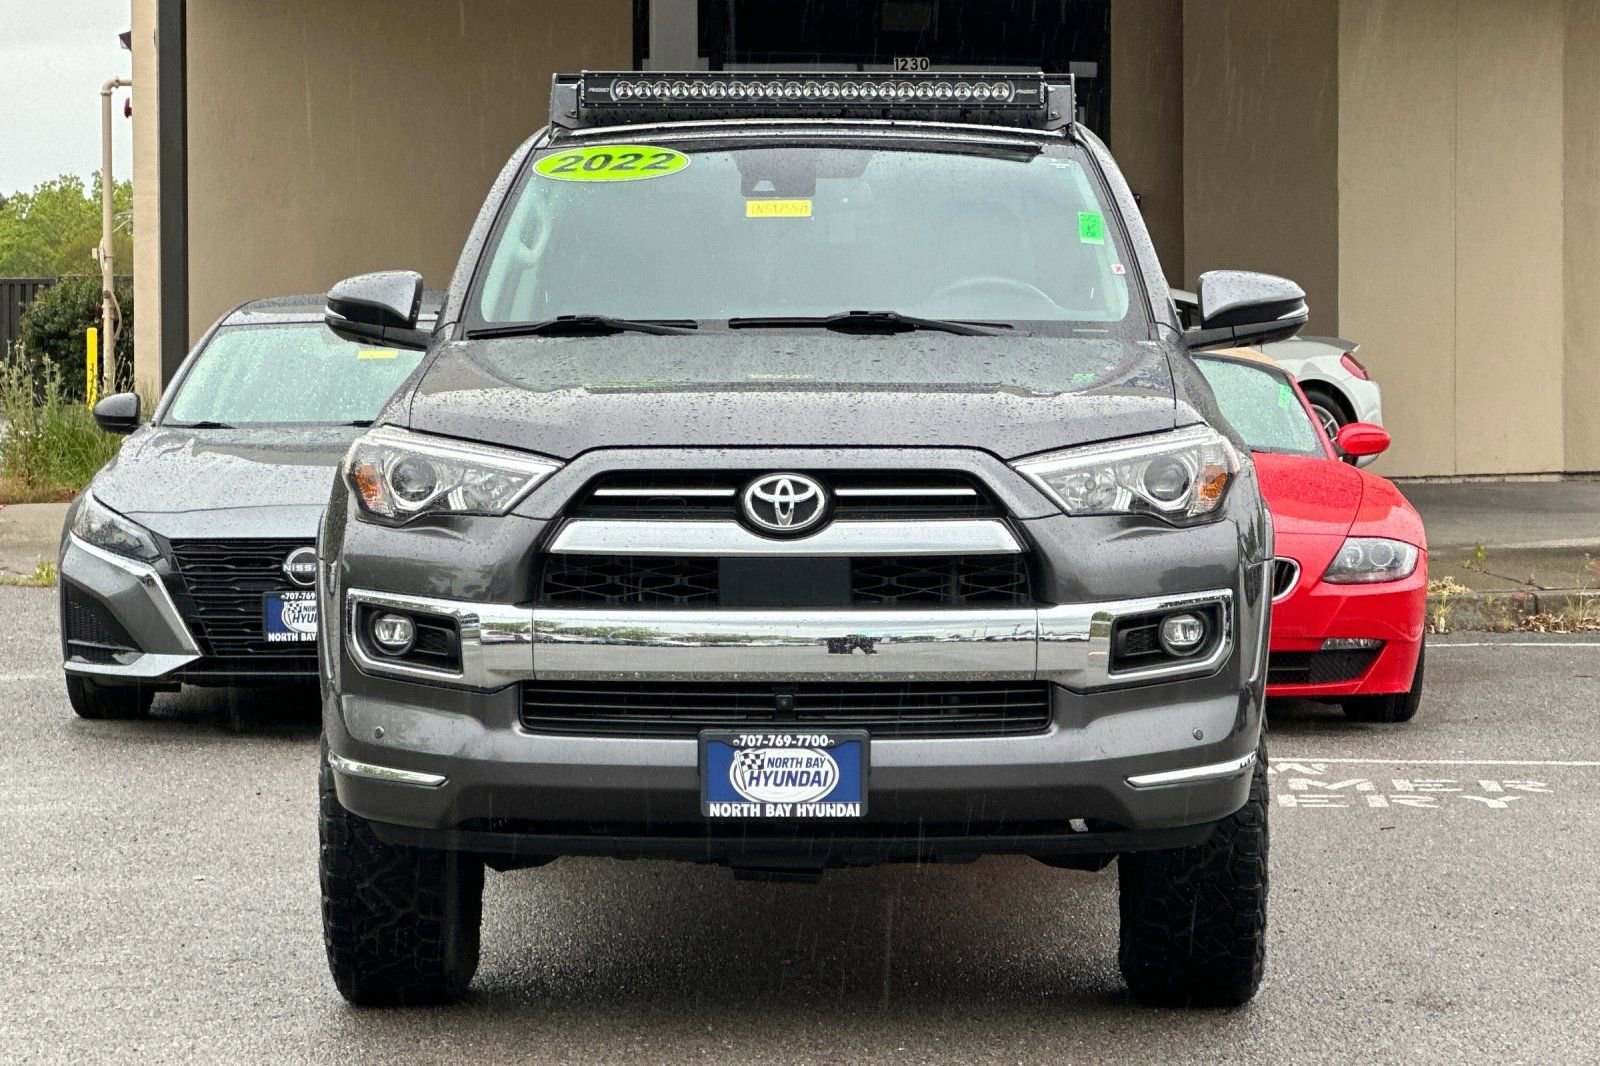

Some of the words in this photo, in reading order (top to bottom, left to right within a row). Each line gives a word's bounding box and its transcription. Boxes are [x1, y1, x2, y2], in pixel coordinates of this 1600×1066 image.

[895, 58, 929, 71] 1230
[550, 153, 676, 174] 2022
[285, 592, 316, 600] 707-769
[268, 633, 298, 642] NORTH
[301, 633, 316, 641] BAY
[739, 735, 828, 747] 707-769-7700
[766, 757, 802, 768] NORTH
[805, 757, 827, 768] BAY
[748, 770, 829, 787] HYUNDAI
[709, 803, 761, 817] NORTH
[765, 803, 793, 817] BAY
[796, 803, 860, 817] HYUNDAI
